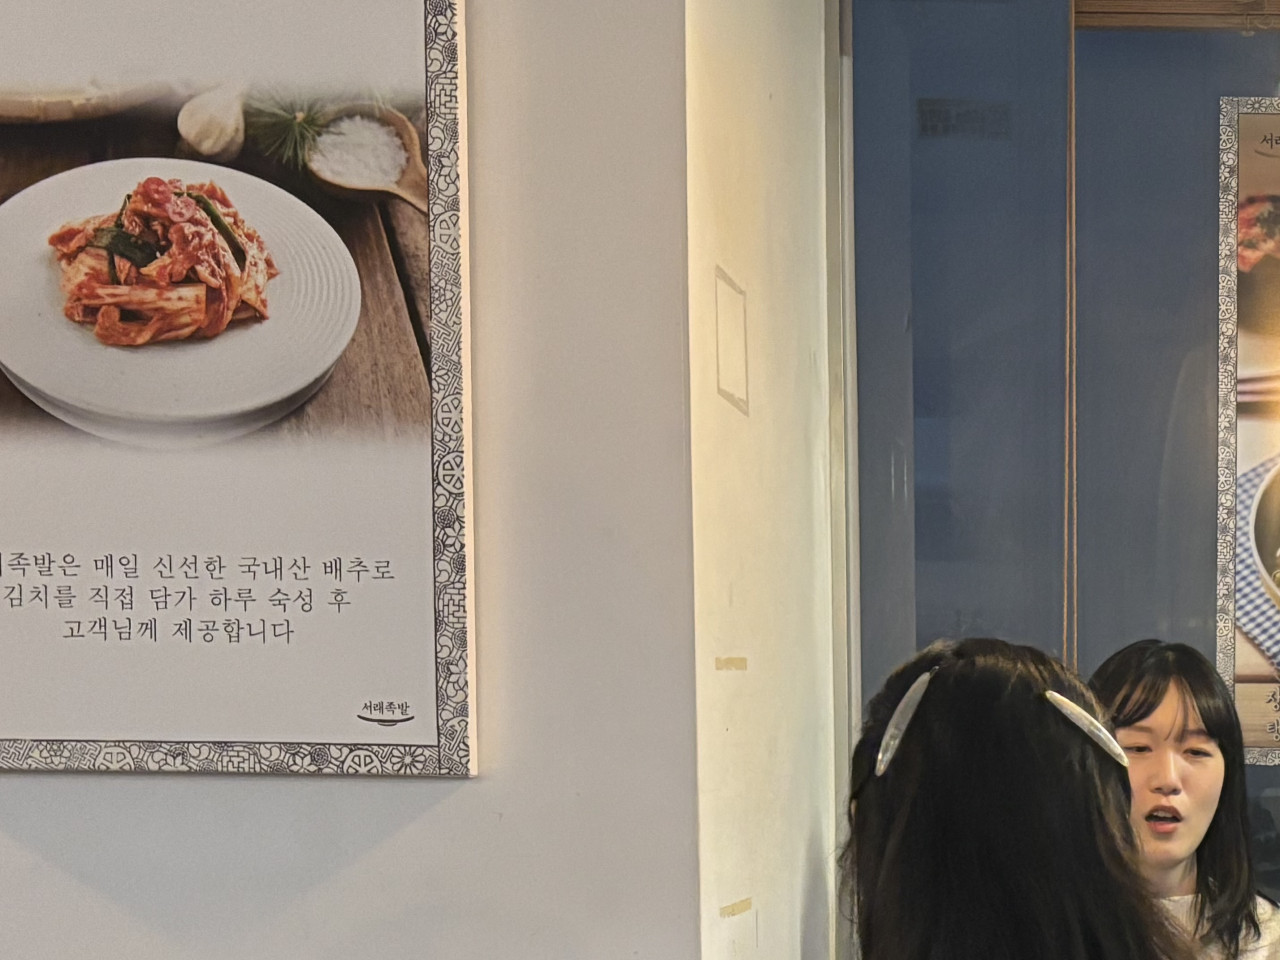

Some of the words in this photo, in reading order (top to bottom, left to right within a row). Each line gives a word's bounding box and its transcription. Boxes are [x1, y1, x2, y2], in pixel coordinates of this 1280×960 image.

[0, 552, 81, 577] 족발은
[93, 553, 139, 579] 매일
[153, 554, 227, 580] 신선한
[238, 555, 311, 581] 국내산
[322, 556, 395, 583] 배추로
[3, 583, 77, 610] 김치를
[90, 584, 134, 611] 직접
[149, 584, 197, 612] 담가
[209, 586, 257, 613] 하루
[268, 587, 313, 613] 숙성
[327, 588, 352, 614] 후
[62, 616, 157, 643] 고객님께
[172, 617, 295, 645] 제공합니다
[361, 701, 410, 716] 서래족발
